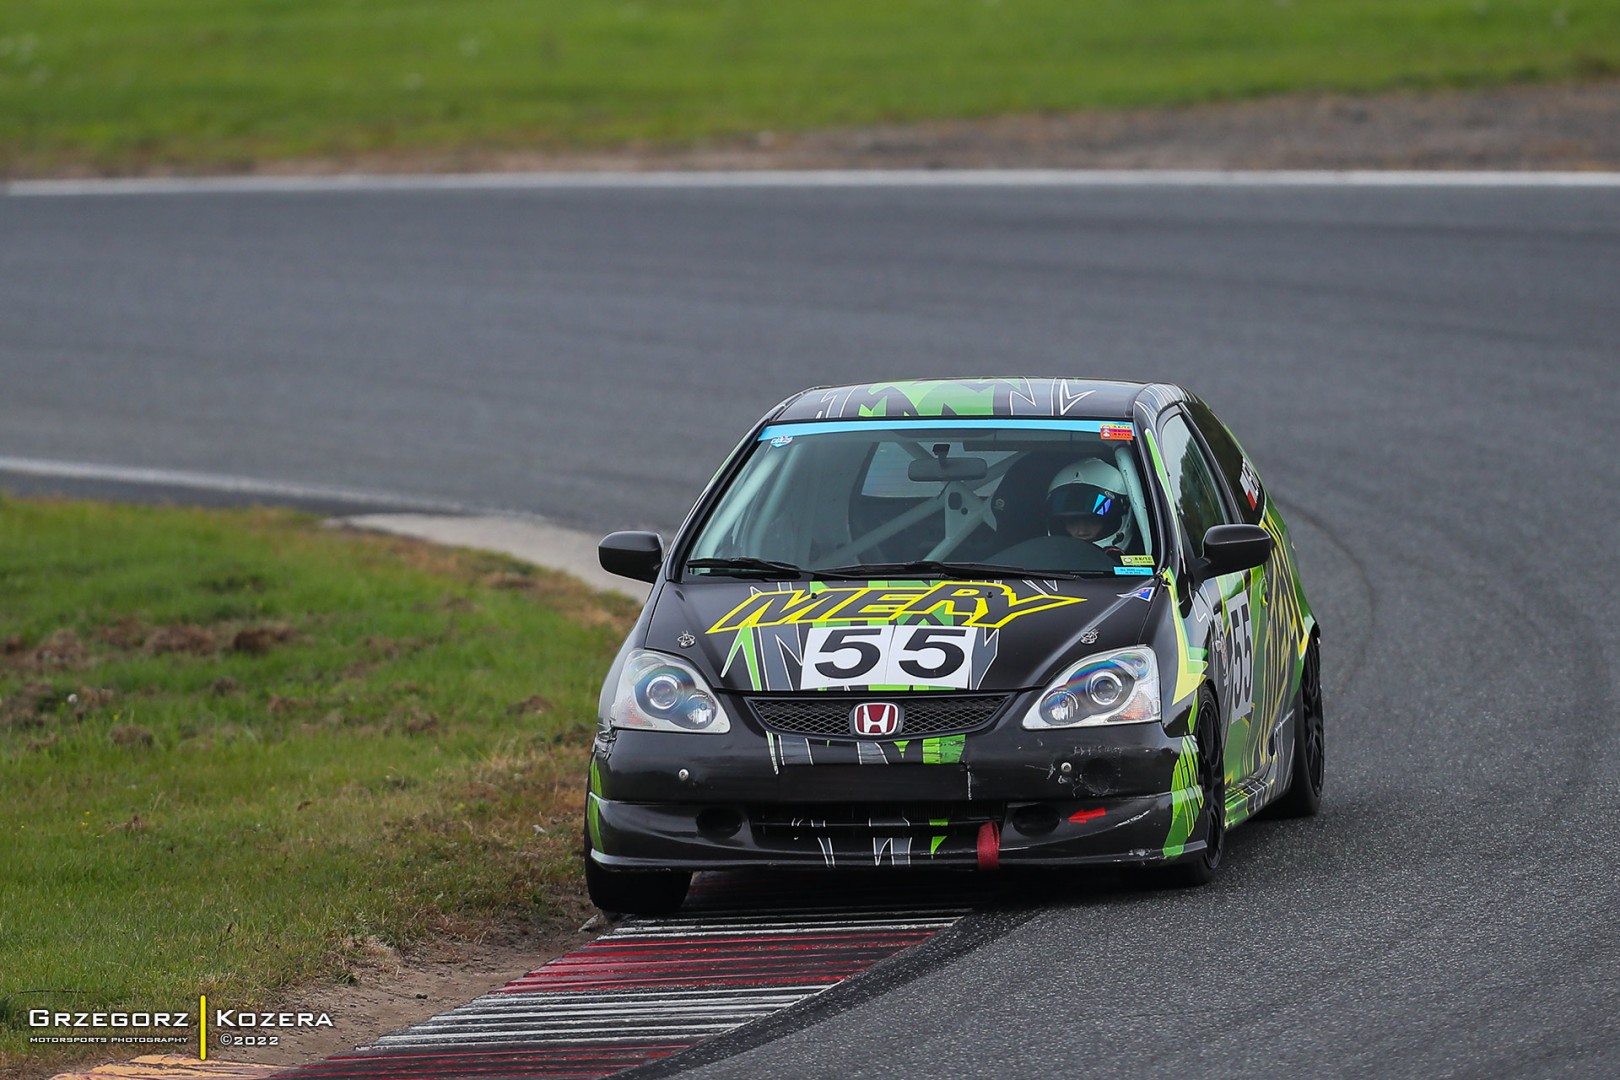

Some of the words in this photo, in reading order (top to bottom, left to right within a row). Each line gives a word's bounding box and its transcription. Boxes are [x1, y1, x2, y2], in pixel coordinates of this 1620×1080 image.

[705, 581, 1087, 634] MERY
[814, 628, 968, 680] 55
[1231, 604, 1253, 709] 55
